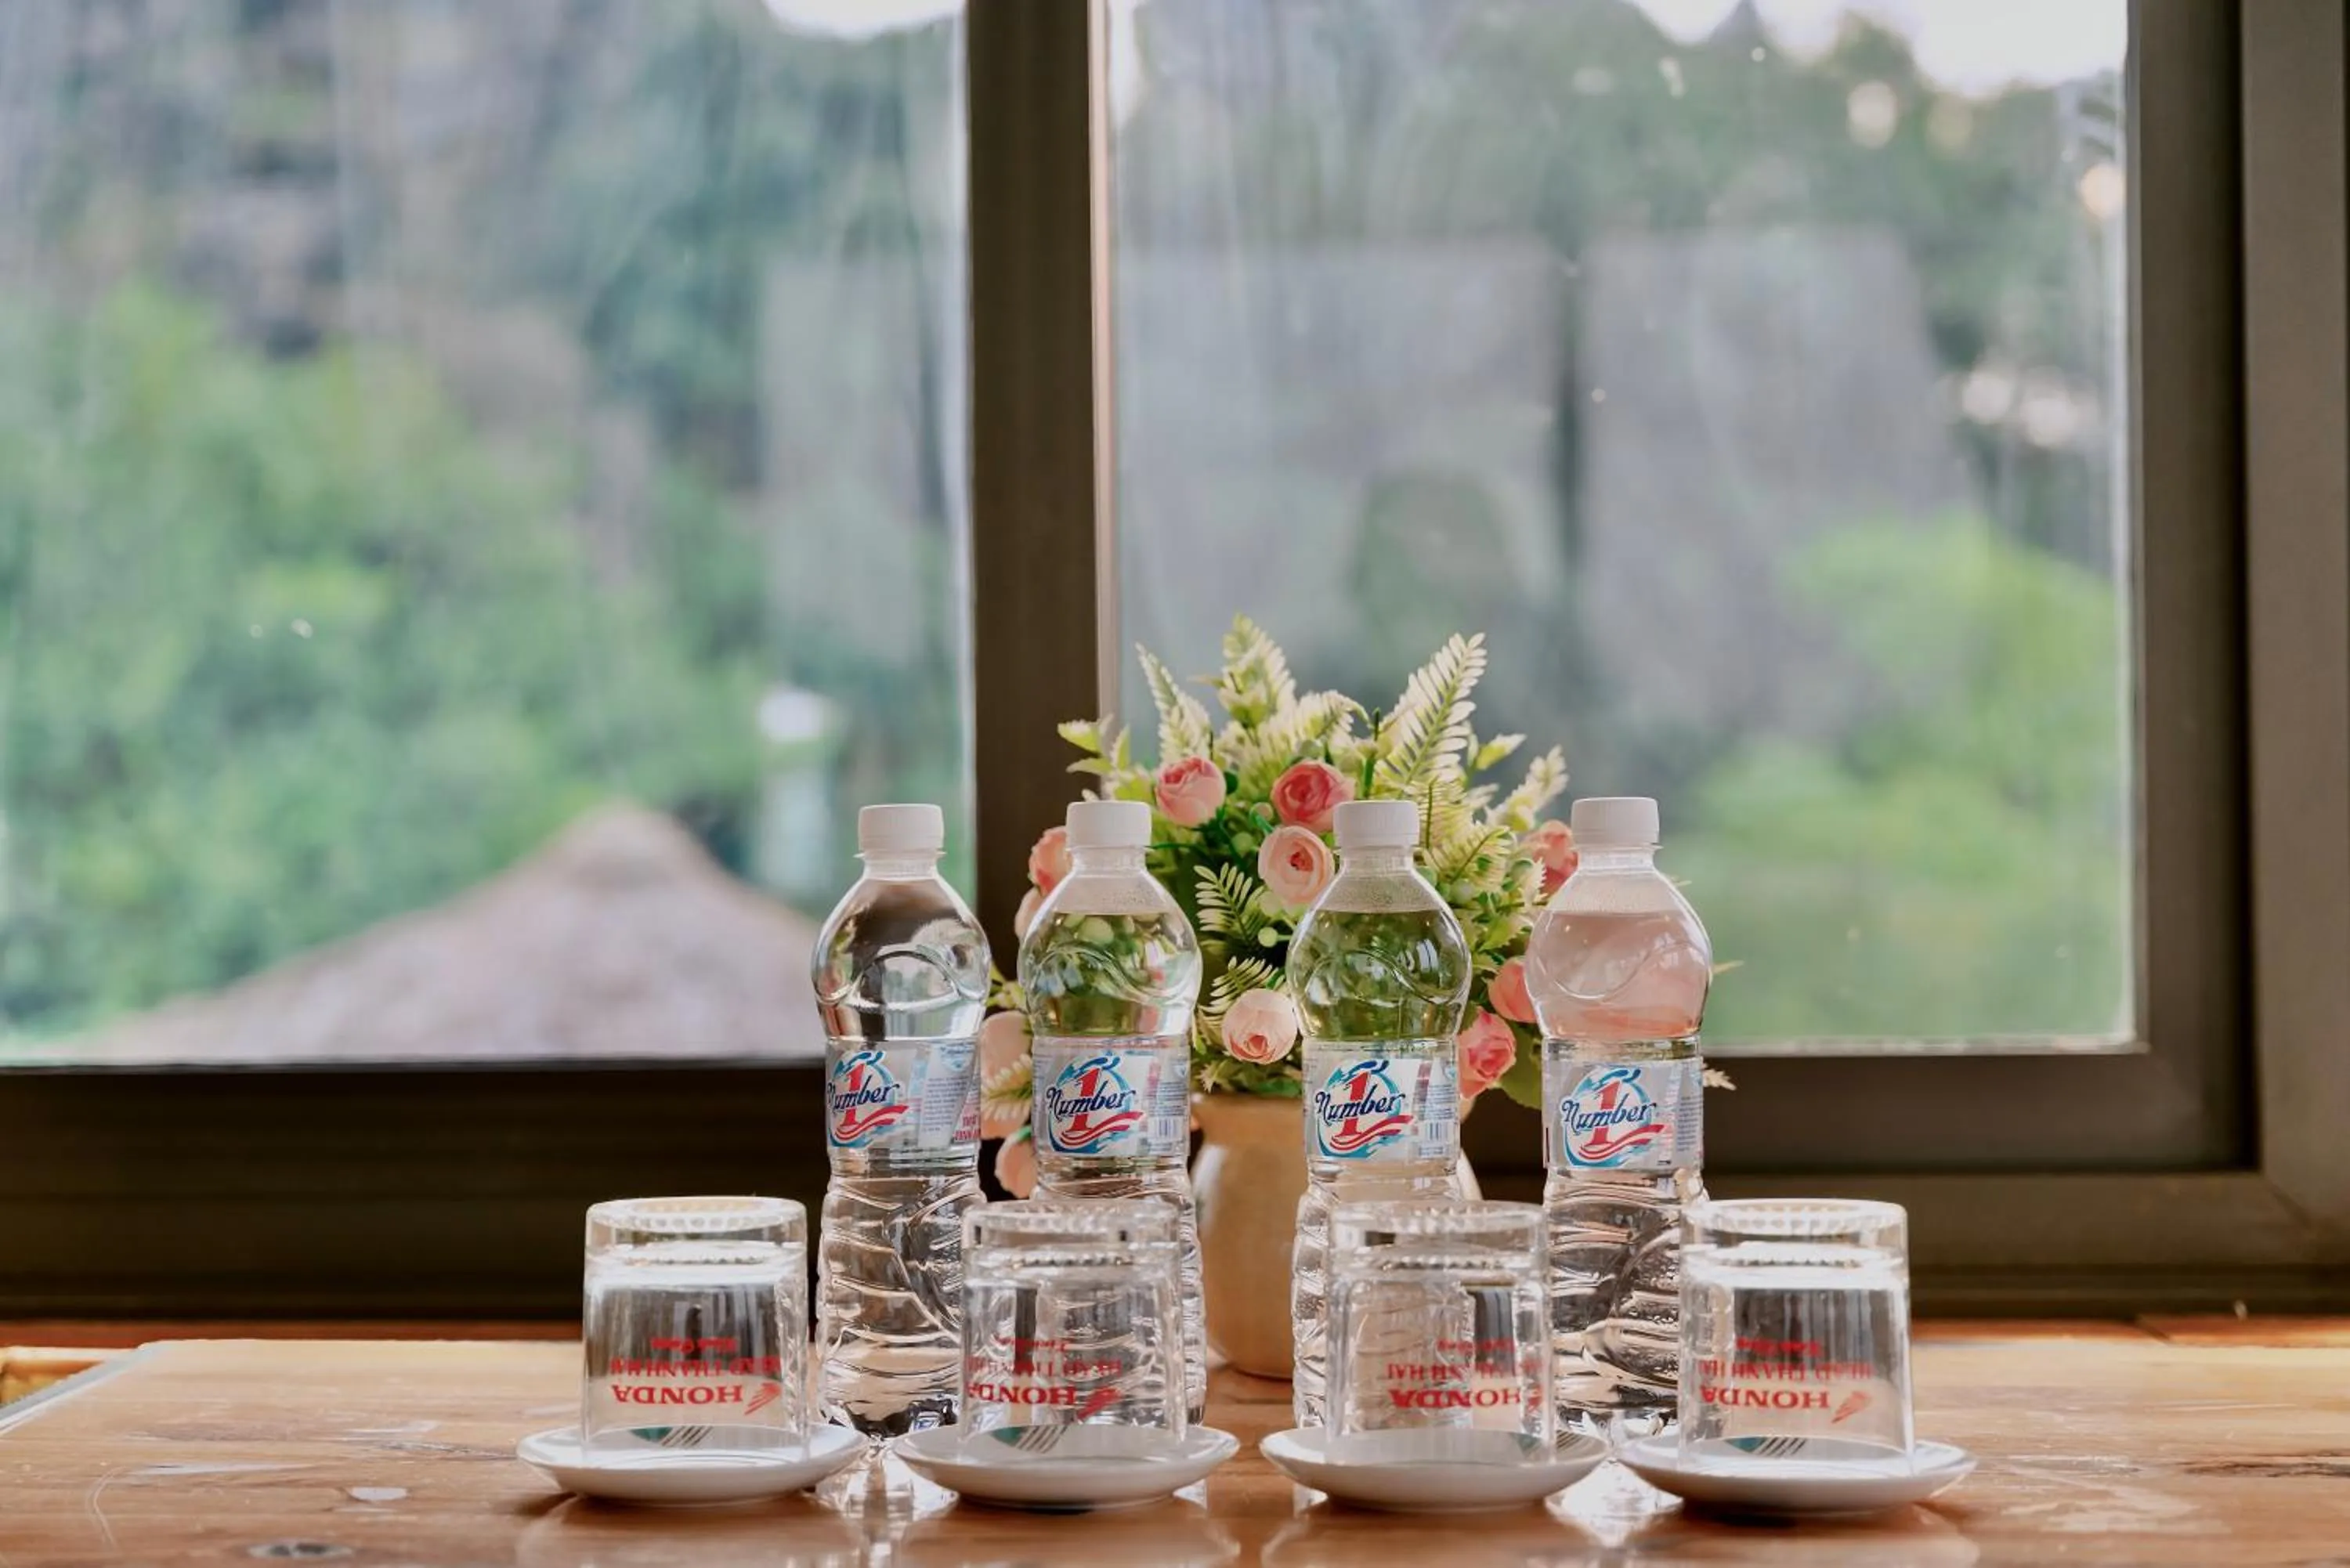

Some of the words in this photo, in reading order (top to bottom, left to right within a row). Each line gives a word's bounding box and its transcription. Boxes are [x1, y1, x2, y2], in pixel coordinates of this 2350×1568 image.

[827, 1075, 900, 1114] Number
[841, 1064, 866, 1126] 1
[1047, 1080, 1136, 1122] Number
[1068, 1068, 1101, 1132] 1
[1315, 1084, 1406, 1126] Number
[1334, 1071, 1369, 1137] 1
[1561, 1093, 1657, 1136] Number
[1587, 1080, 1622, 1145] 1
[611, 1384, 744, 1405] HONDA
[1388, 1388, 1522, 1408] HONDA
[1699, 1385, 1830, 1409] HONDA
